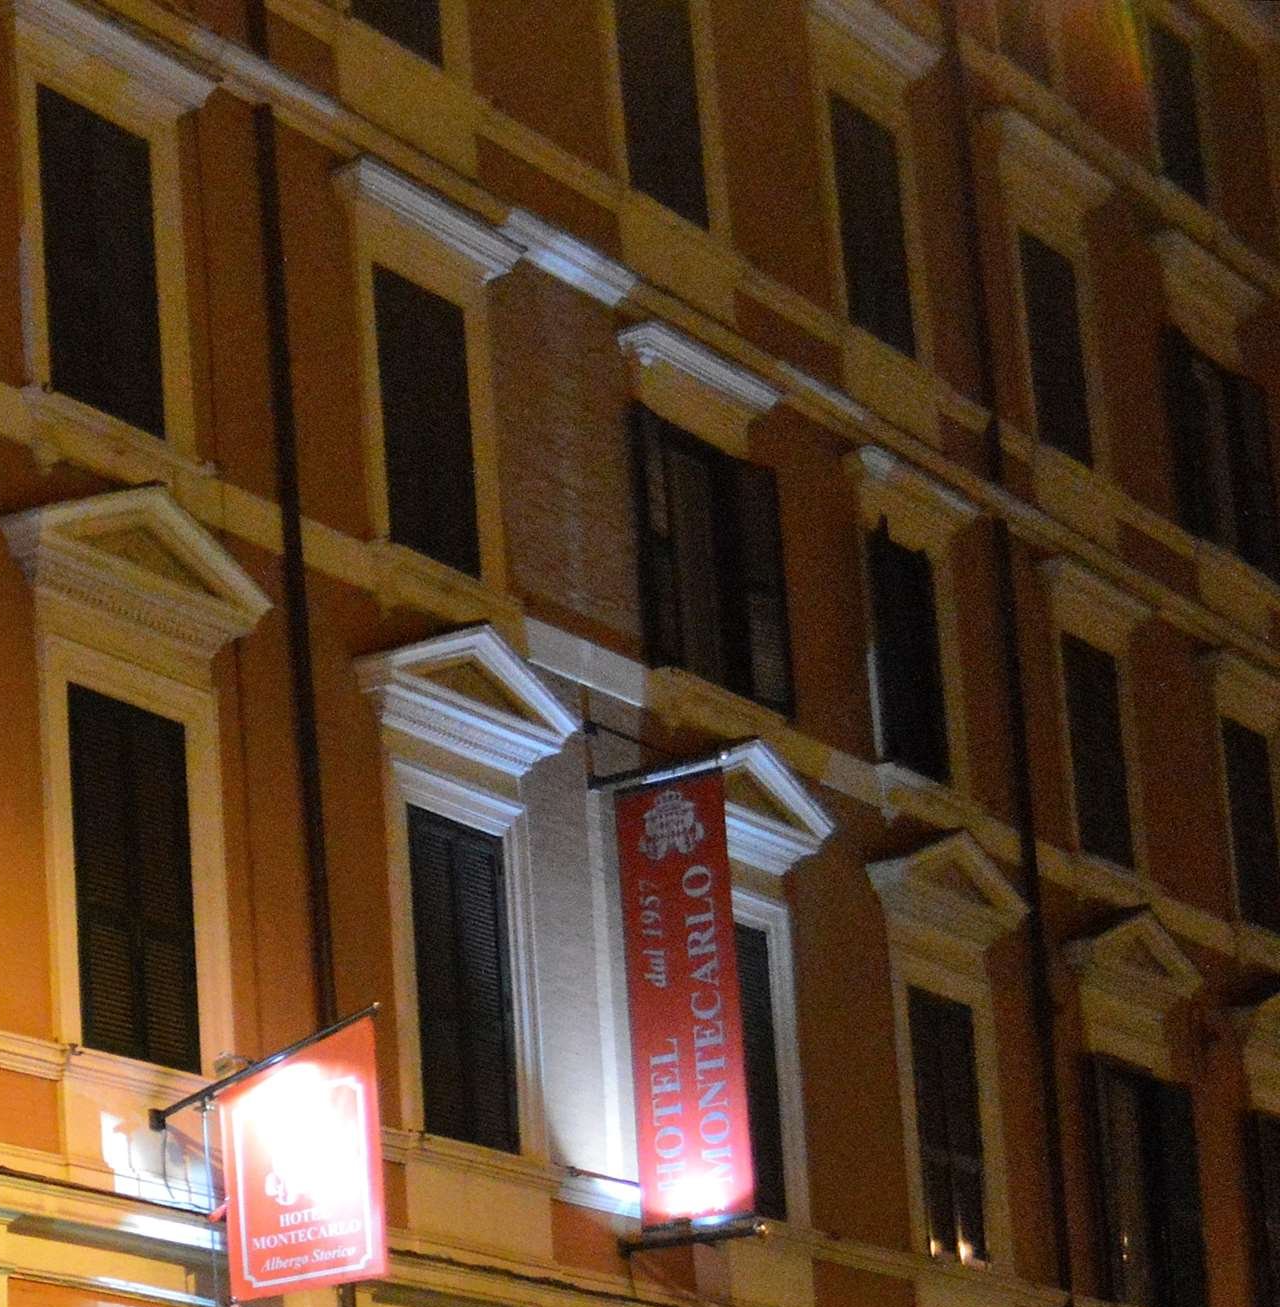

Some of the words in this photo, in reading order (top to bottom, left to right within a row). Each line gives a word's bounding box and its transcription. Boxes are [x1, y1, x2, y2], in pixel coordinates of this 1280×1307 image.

[639, 879, 663, 939] 1957
[642, 949, 669, 988] dal
[682, 864, 734, 1187] MONTECARLO
[649, 1037, 687, 1192] HOTEL
[252, 1218, 361, 1250] MONTECARLO
[260, 1255, 309, 1273] Albergo
[311, 1246, 357, 1263] Storico
